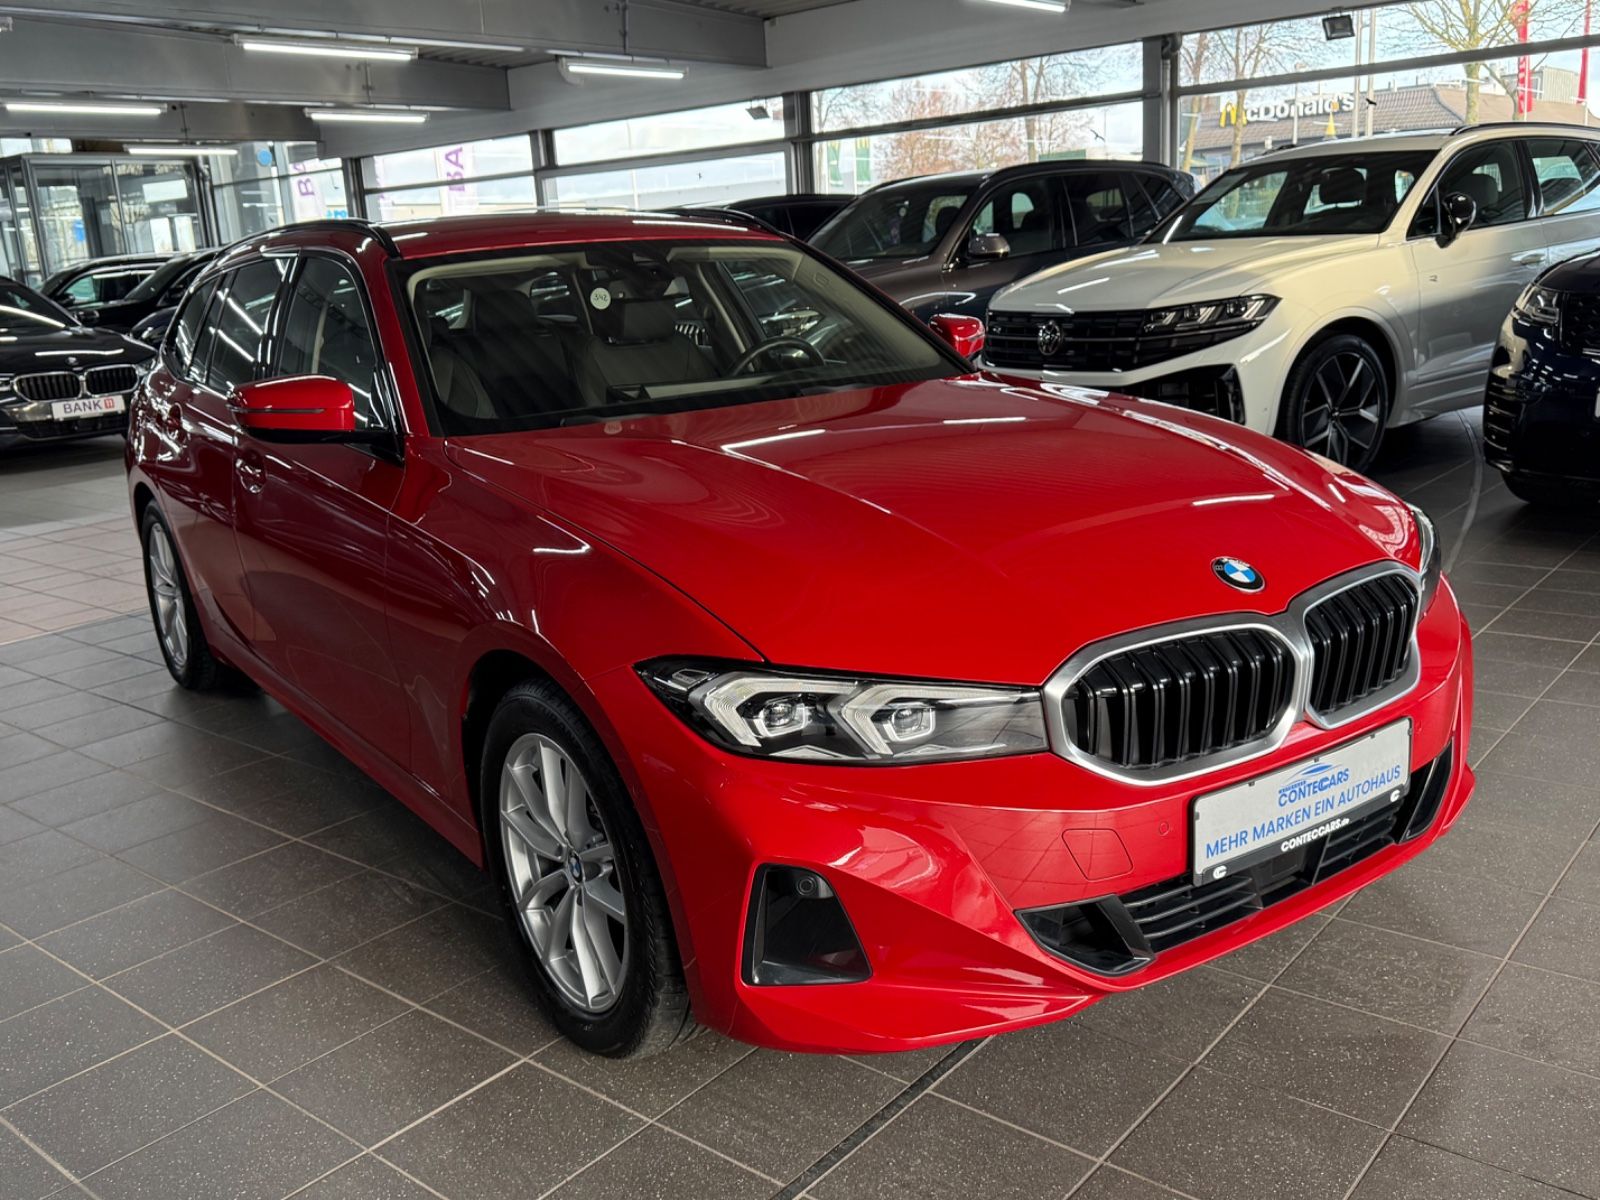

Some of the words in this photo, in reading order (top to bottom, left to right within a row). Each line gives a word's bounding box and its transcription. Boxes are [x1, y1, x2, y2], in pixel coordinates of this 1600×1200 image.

[63, 399, 102, 414] BANK
[1206, 830, 1248, 859] MEHR
[1252, 807, 1311, 841] MARKEN
[1314, 795, 1335, 817] EIN
[1338, 765, 1401, 807] AUTOHAUS
[1281, 818, 1350, 852] CONTECCARS.de
